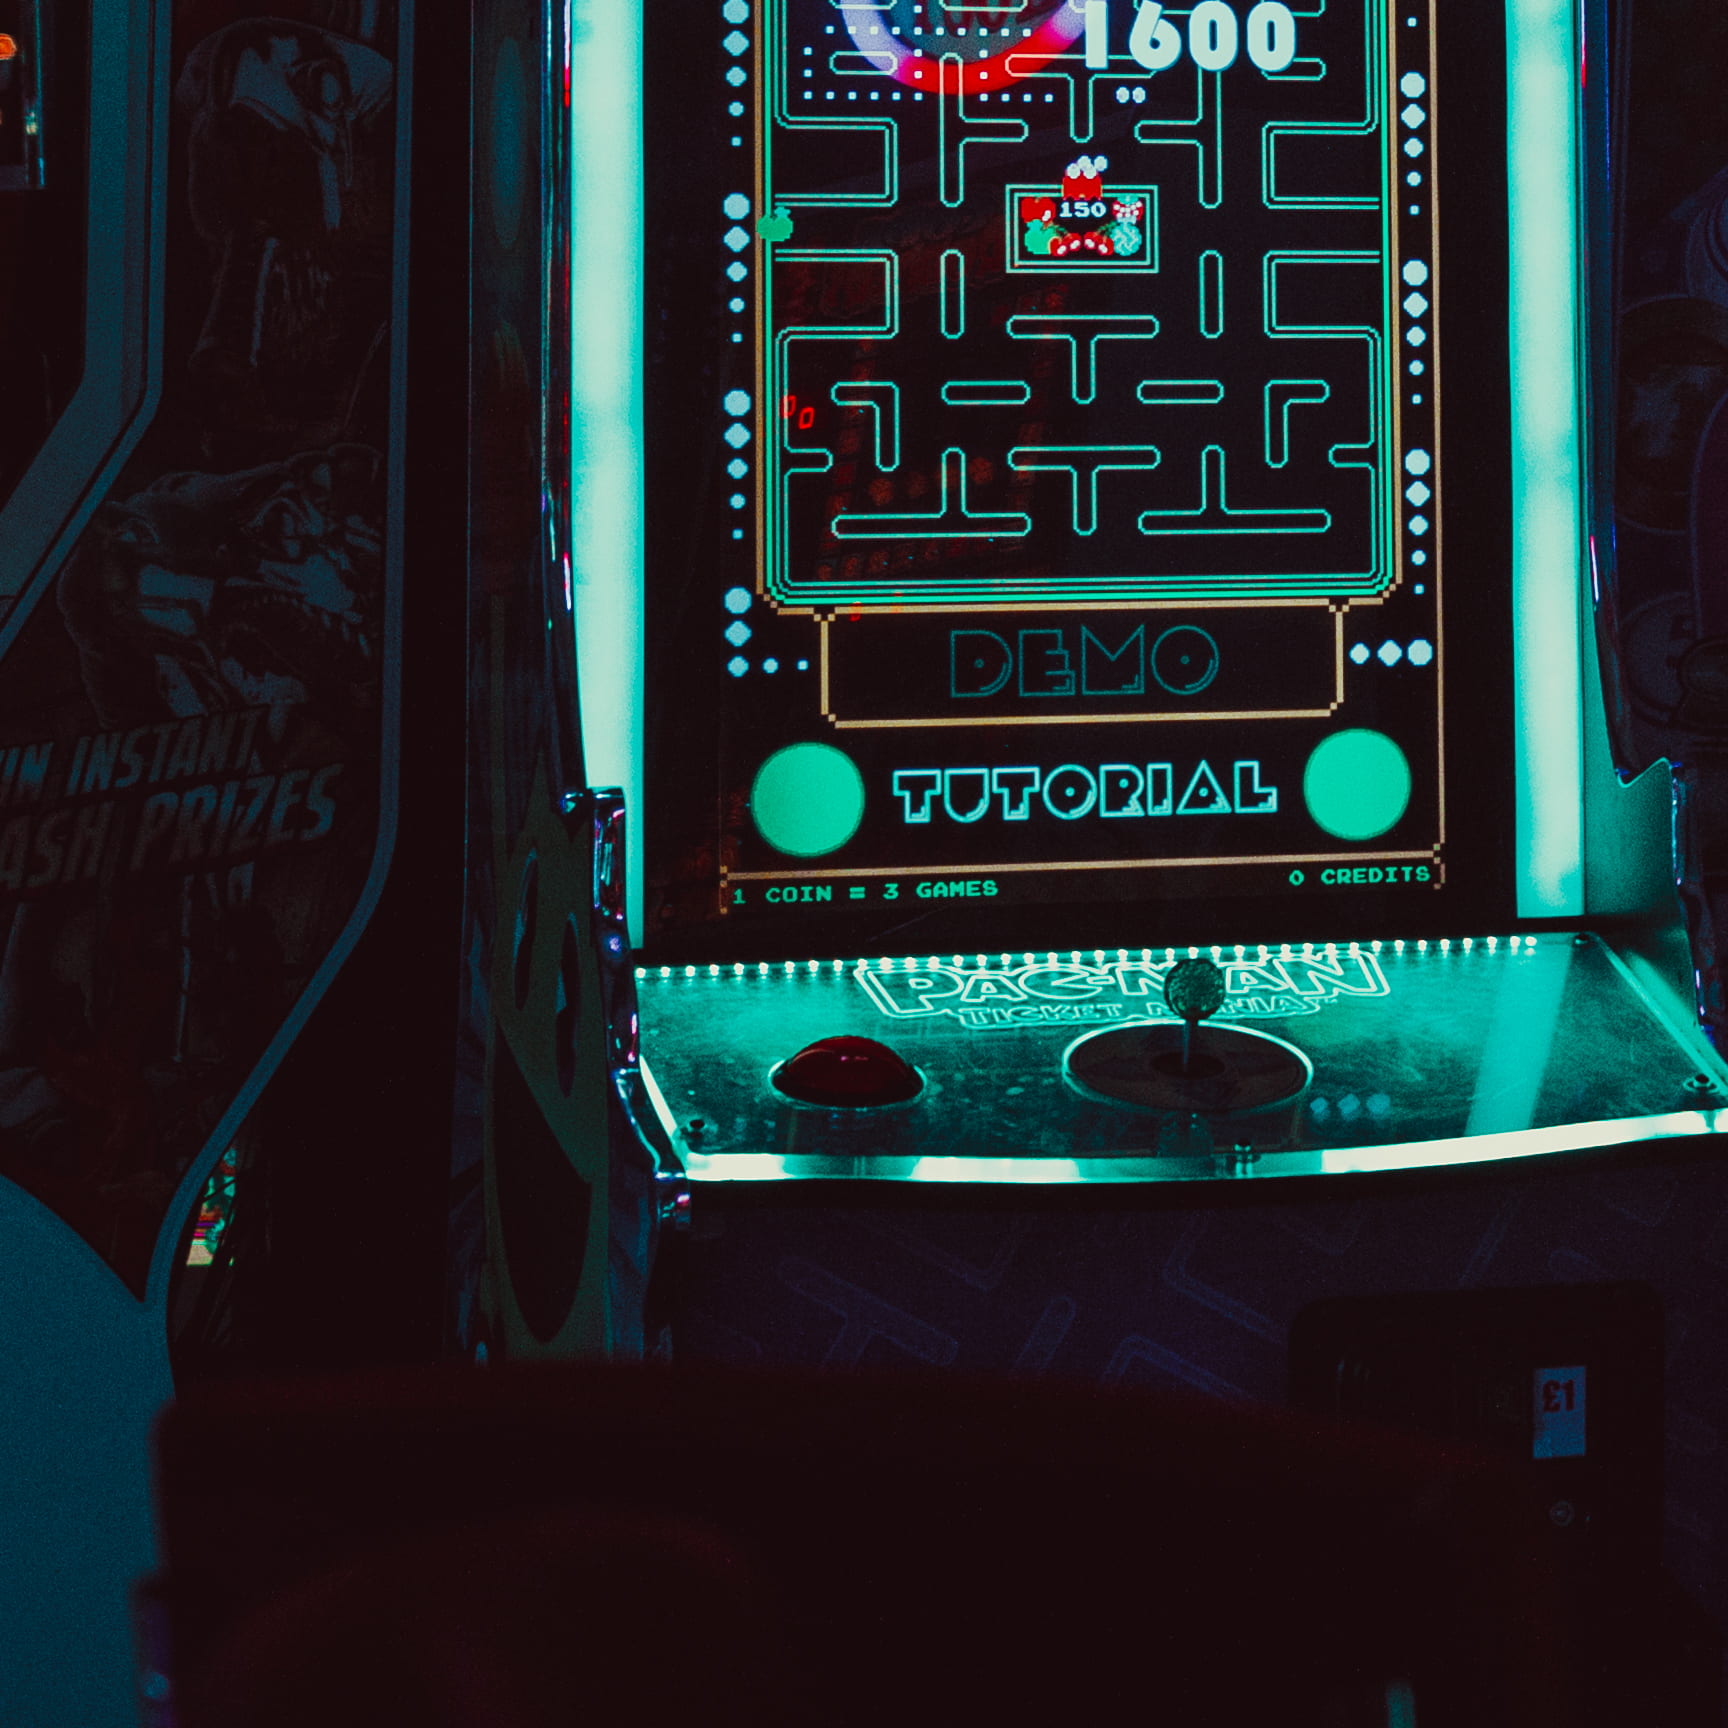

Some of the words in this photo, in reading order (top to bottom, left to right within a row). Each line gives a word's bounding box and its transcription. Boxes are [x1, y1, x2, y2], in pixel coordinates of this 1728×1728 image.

[1059, 201, 1107, 218] 150
[949, 624, 1220, 699] DEMO
[65, 708, 264, 797] INSTANT
[892, 759, 1279, 824] TUTORIAL
[0, 800, 115, 890] ASH
[130, 763, 345, 872] PRIZES
[732, 888, 746, 905] 1
[765, 883, 833, 904] COIN
[883, 882, 900, 900] 3
[916, 879, 999, 899] GAMES
[1321, 865, 1431, 886] CREDITS
[957, 1003, 1122, 1026] TICKET
[1542, 1379, 1576, 1413] £1
